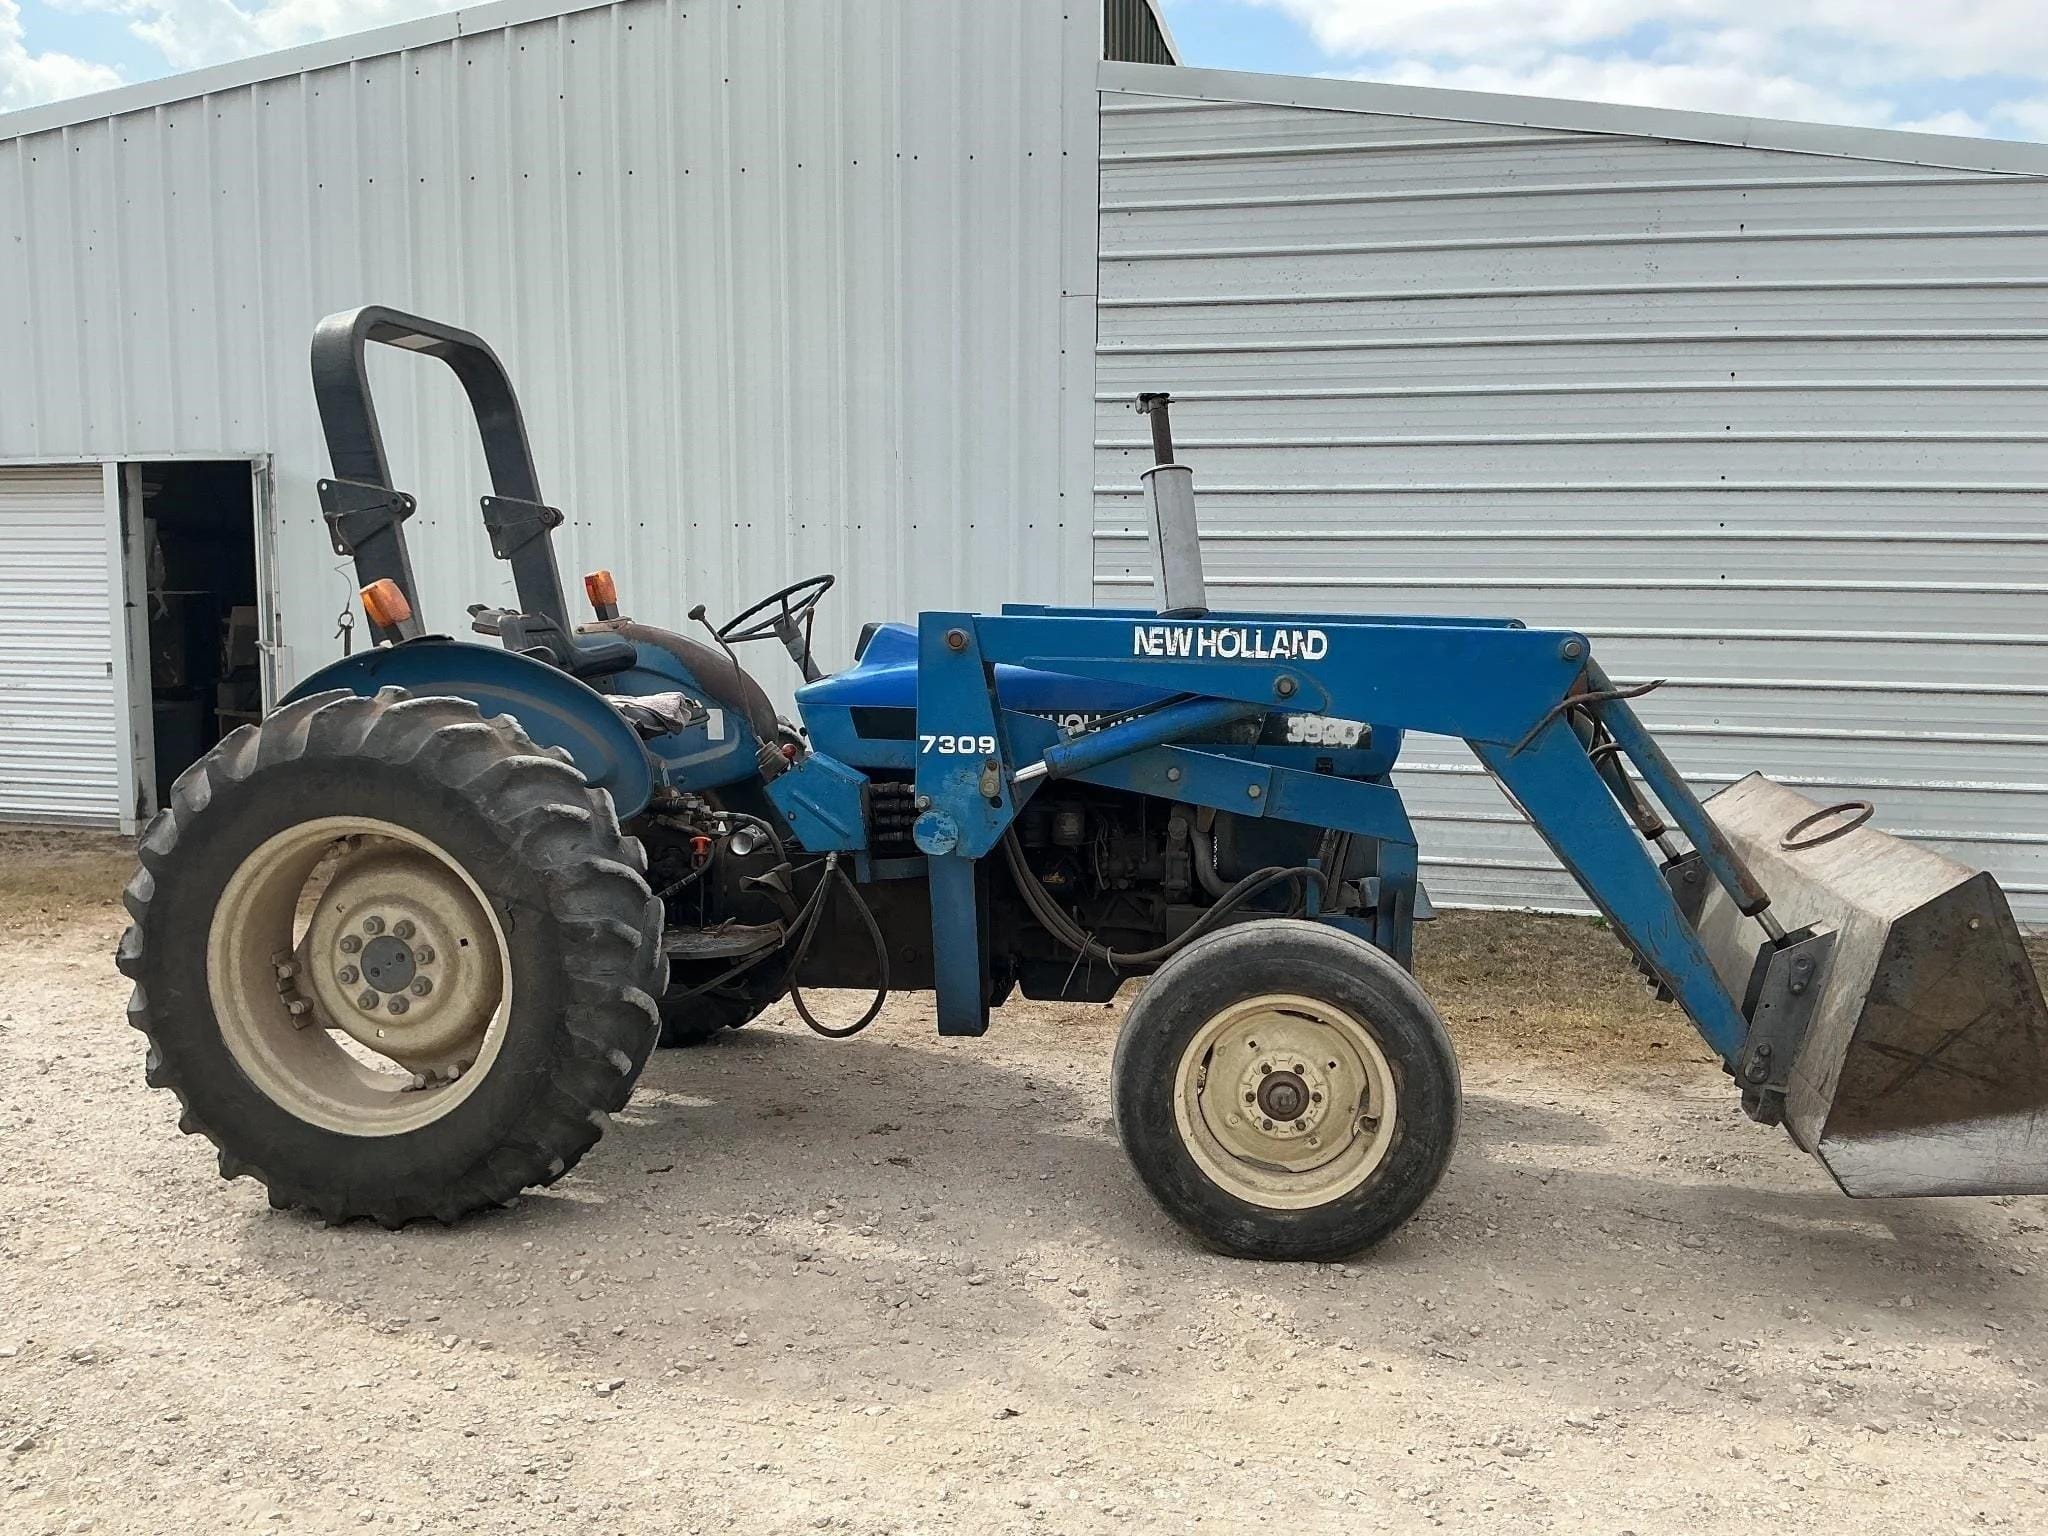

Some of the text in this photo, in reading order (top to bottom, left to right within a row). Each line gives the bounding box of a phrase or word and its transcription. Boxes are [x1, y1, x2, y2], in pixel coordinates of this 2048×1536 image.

[1134, 626, 1328, 660] NEW HOLLAND
[919, 735, 996, 754] 7309
